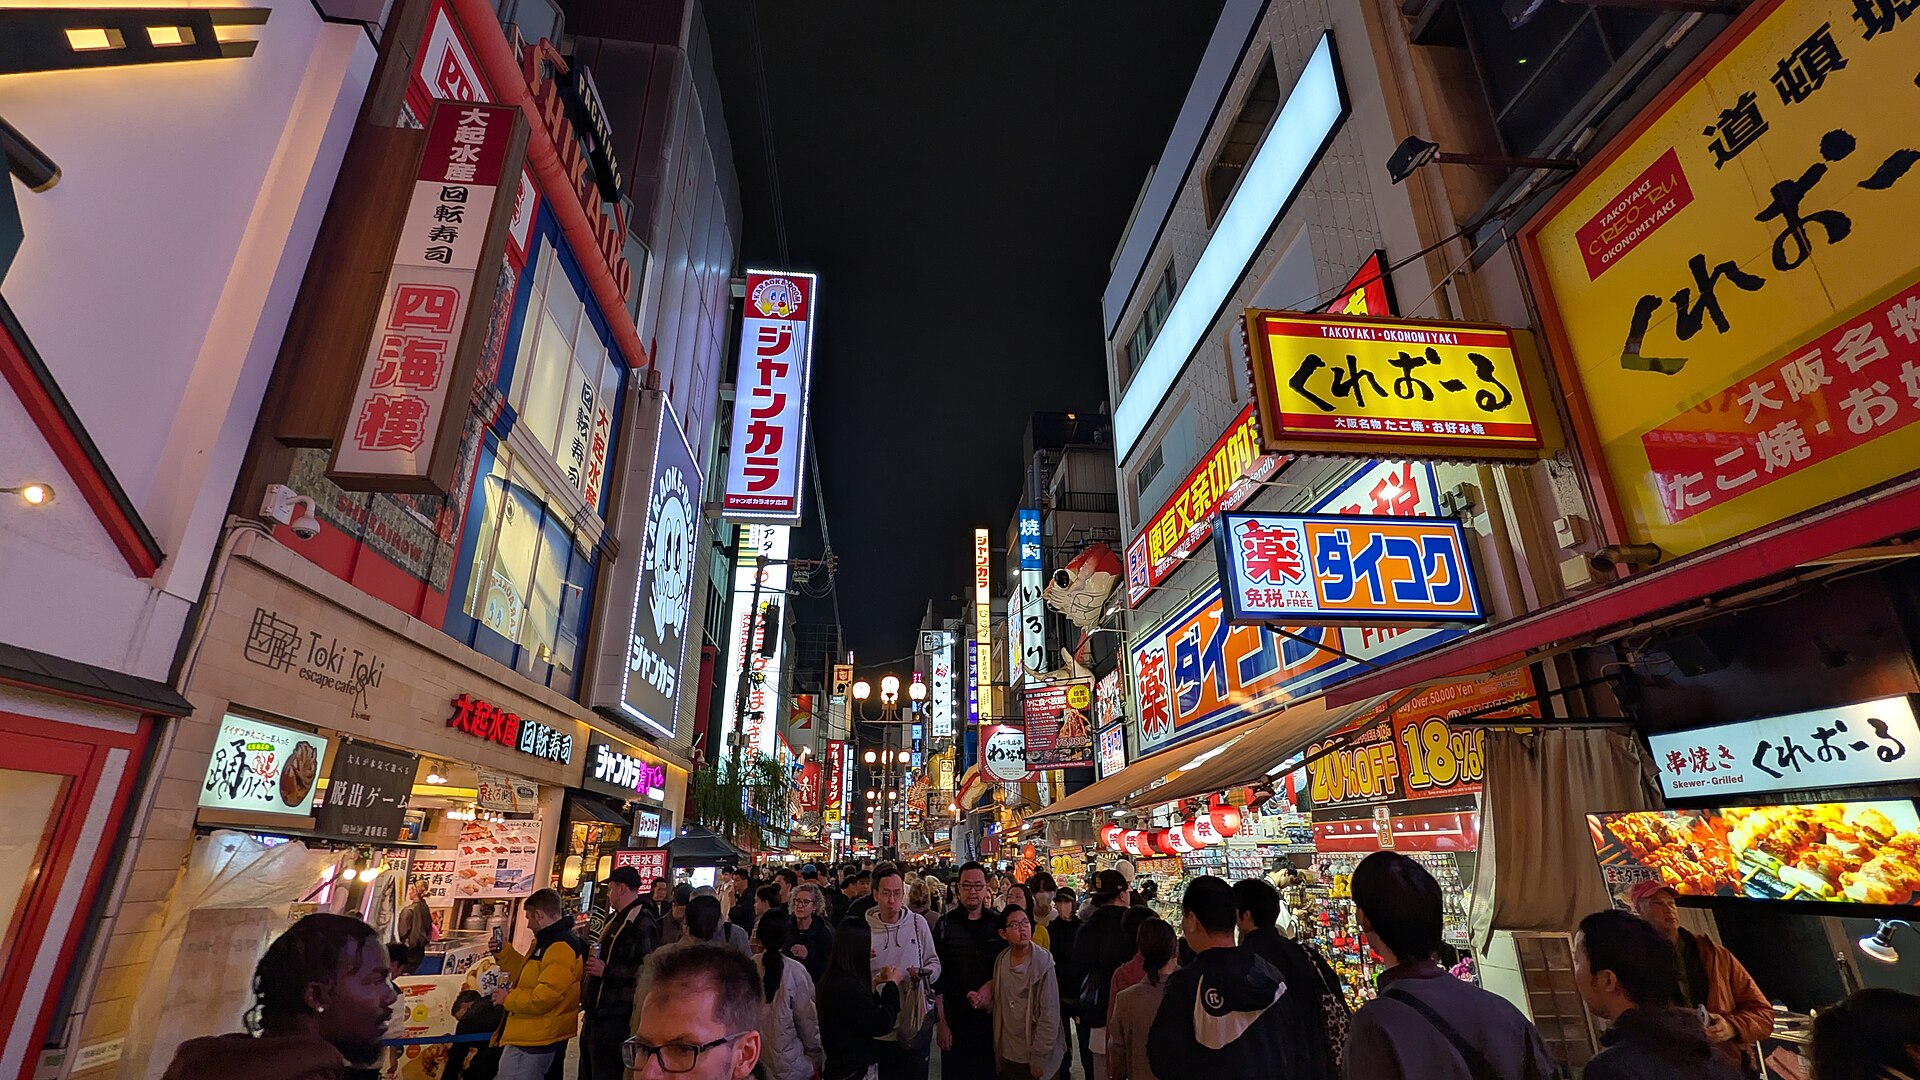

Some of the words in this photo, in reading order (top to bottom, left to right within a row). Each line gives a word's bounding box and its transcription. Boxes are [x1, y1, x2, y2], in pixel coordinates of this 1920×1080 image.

[443, 107, 491, 183] 大起水産
[578, 73, 621, 190] PACHINKO
[423, 185, 469, 265] 回転寿司
[1600, 180, 1652, 228] TAKOYAKI
[1601, 198, 1677, 264] OKONOMIYAKI
[1621, 128, 1920, 376] くれおー
[353, 282, 462, 454] 四海樓
[1288, 346, 1512, 413] くれおーる
[743, 324, 793, 493] ジャンカラ
[1334, 417, 1382, 431] 大阪名物
[977, 536, 988, 589] ジャンカラ
[1020, 518, 1041, 560] 焼肉
[1241, 524, 1304, 582] 薬
[1313, 529, 1465, 605] ダイコク
[1244, 587, 1285, 609] 免税
[1286, 599, 1314, 608] FREE
[1288, 590, 1309, 599] TAX
[1023, 585, 1044, 673] いろり
[299, 667, 335, 690] escape
[335, 679, 356, 696] cafe
[307, 631, 347, 675] Toki
[350, 650, 385, 689] Toki
[630, 634, 676, 699] ジャンカラ
[1134, 648, 1170, 740] 薬
[1411, 696, 1429, 709] Over
[1429, 687, 1457, 707] 50,000
[1457, 683, 1475, 697] Yen
[446, 693, 521, 748] 大起水産
[521, 720, 575, 766] 回転寿司
[1751, 718, 1907, 778] くれおーる
[595, 744, 641, 790] ジャンカラ
[1665, 744, 1736, 776] 串焼き
[329, 780, 408, 809] 脱出ゲーム
[640, 815, 660, 833] ジャンカラ
[412, 861, 455, 871] 大起水産
[619, 854, 663, 866] 大起水産
